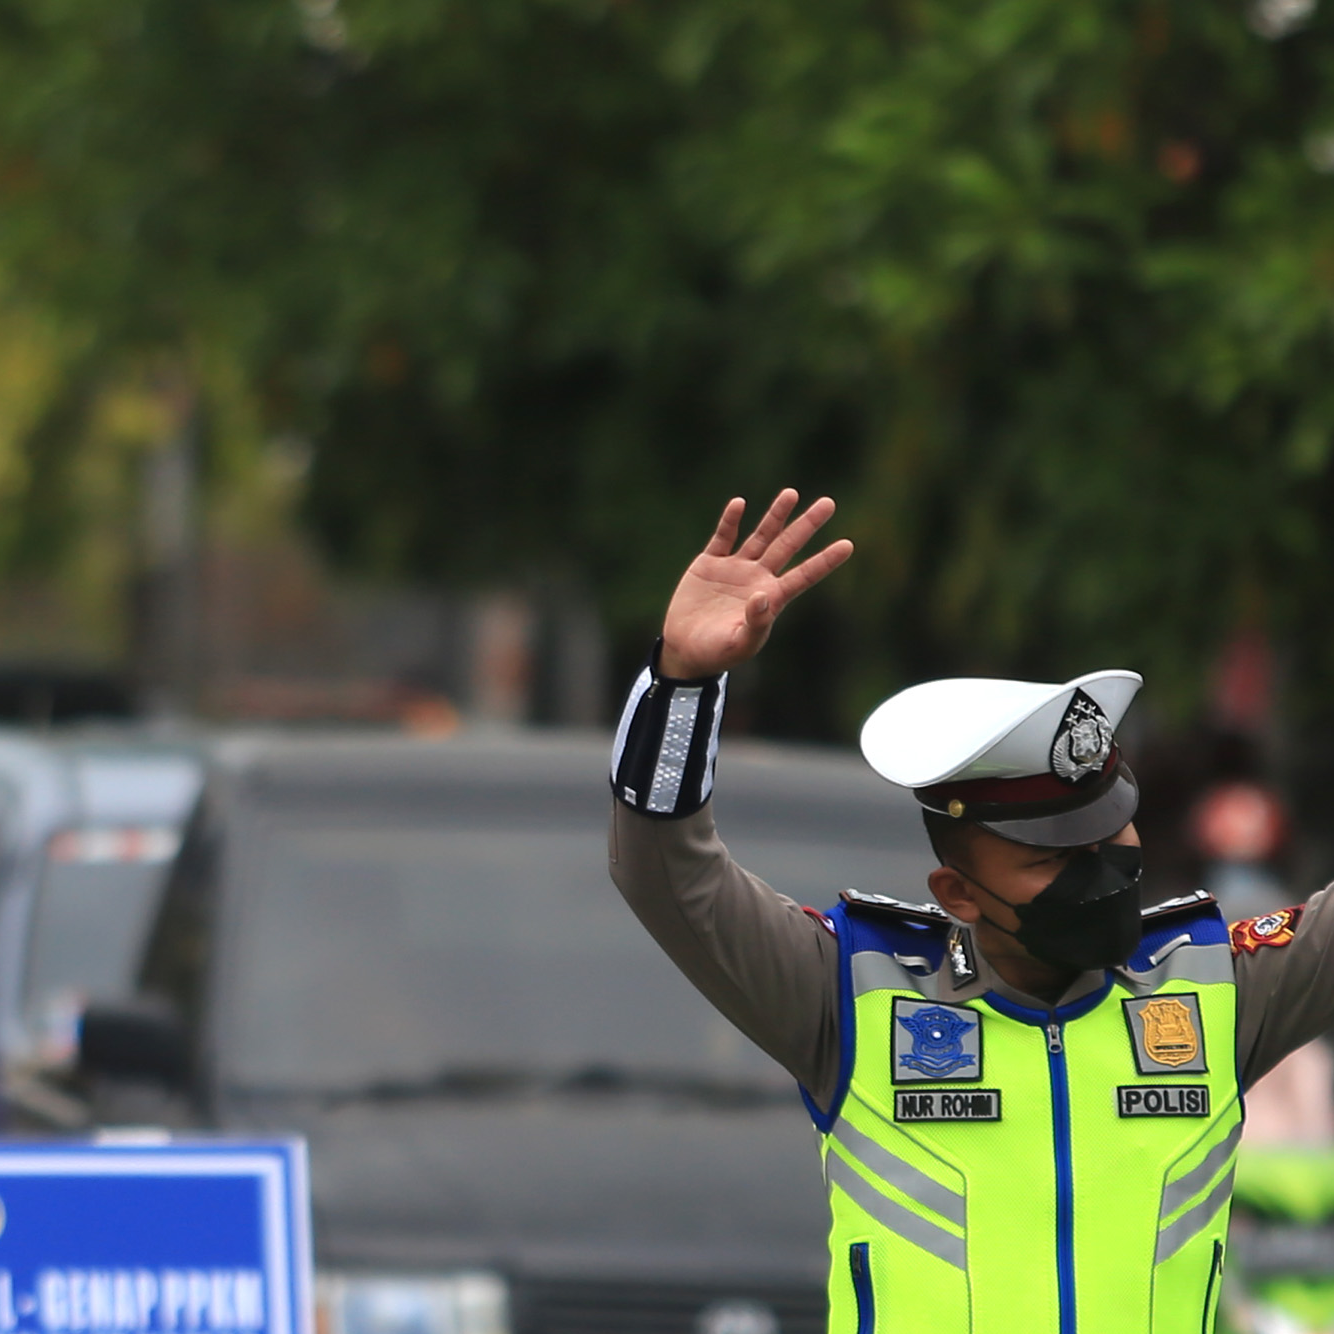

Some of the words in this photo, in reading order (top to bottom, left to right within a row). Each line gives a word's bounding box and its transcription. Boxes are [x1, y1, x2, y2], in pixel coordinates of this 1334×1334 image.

[902, 1094, 934, 1117] NUR
[1125, 1089, 1206, 1113] POLISI
[39, 1269, 158, 1332] GENAP
[161, 1270, 264, 1331] PPKM
